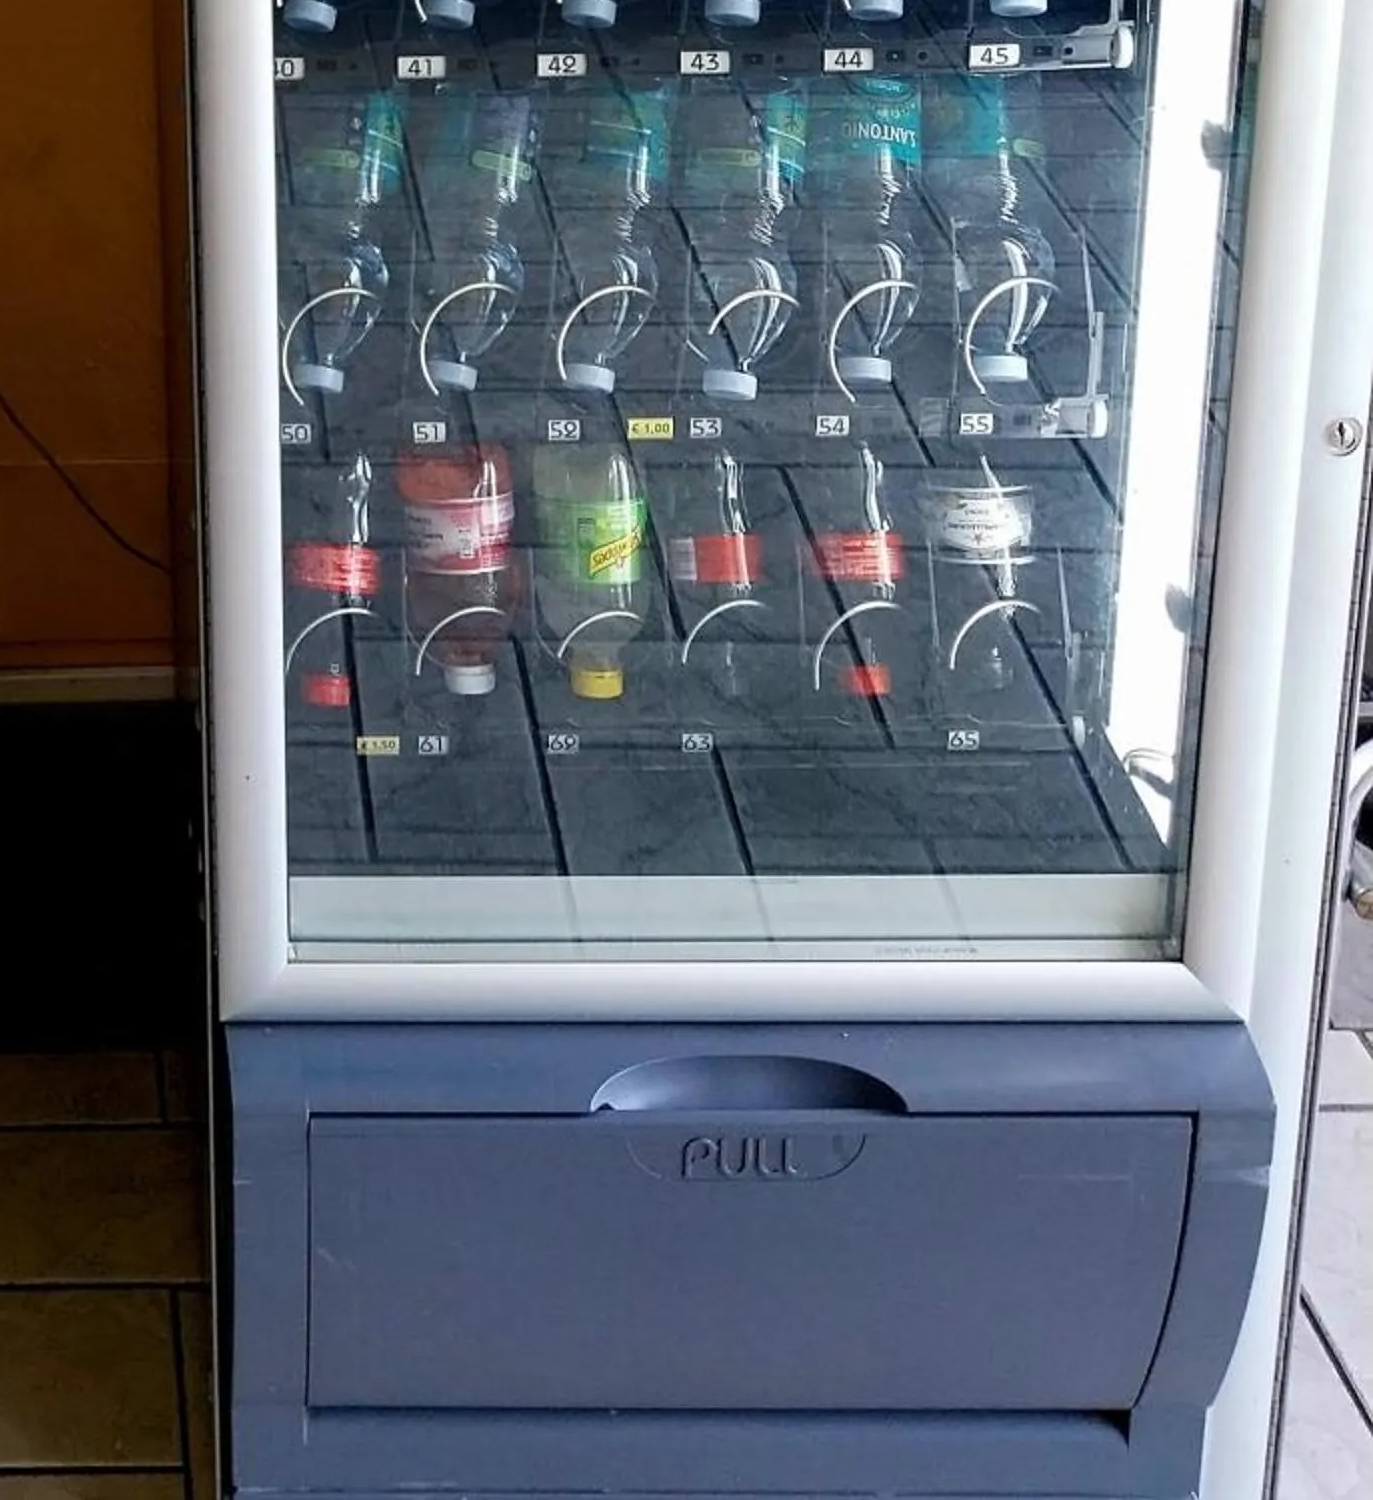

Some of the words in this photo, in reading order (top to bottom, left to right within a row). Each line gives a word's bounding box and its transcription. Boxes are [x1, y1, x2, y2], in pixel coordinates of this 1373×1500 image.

[548, 55, 577, 74] 42
[690, 53, 720, 72] 43
[834, 51, 863, 69] 44
[980, 47, 1009, 65] 45
[275, 59, 294, 78] 0
[407, 59, 433, 77] 41
[281, 425, 308, 441] 50
[416, 424, 440, 441] 51
[549, 421, 578, 439] 52
[692, 419, 719, 437] 53
[819, 417, 844, 435] 54
[962, 415, 990, 433] 55
[420, 737, 442, 753] 61
[684, 734, 711, 752] 63
[949, 731, 977, 749] 65
[681, 1137, 801, 1179] PULL
